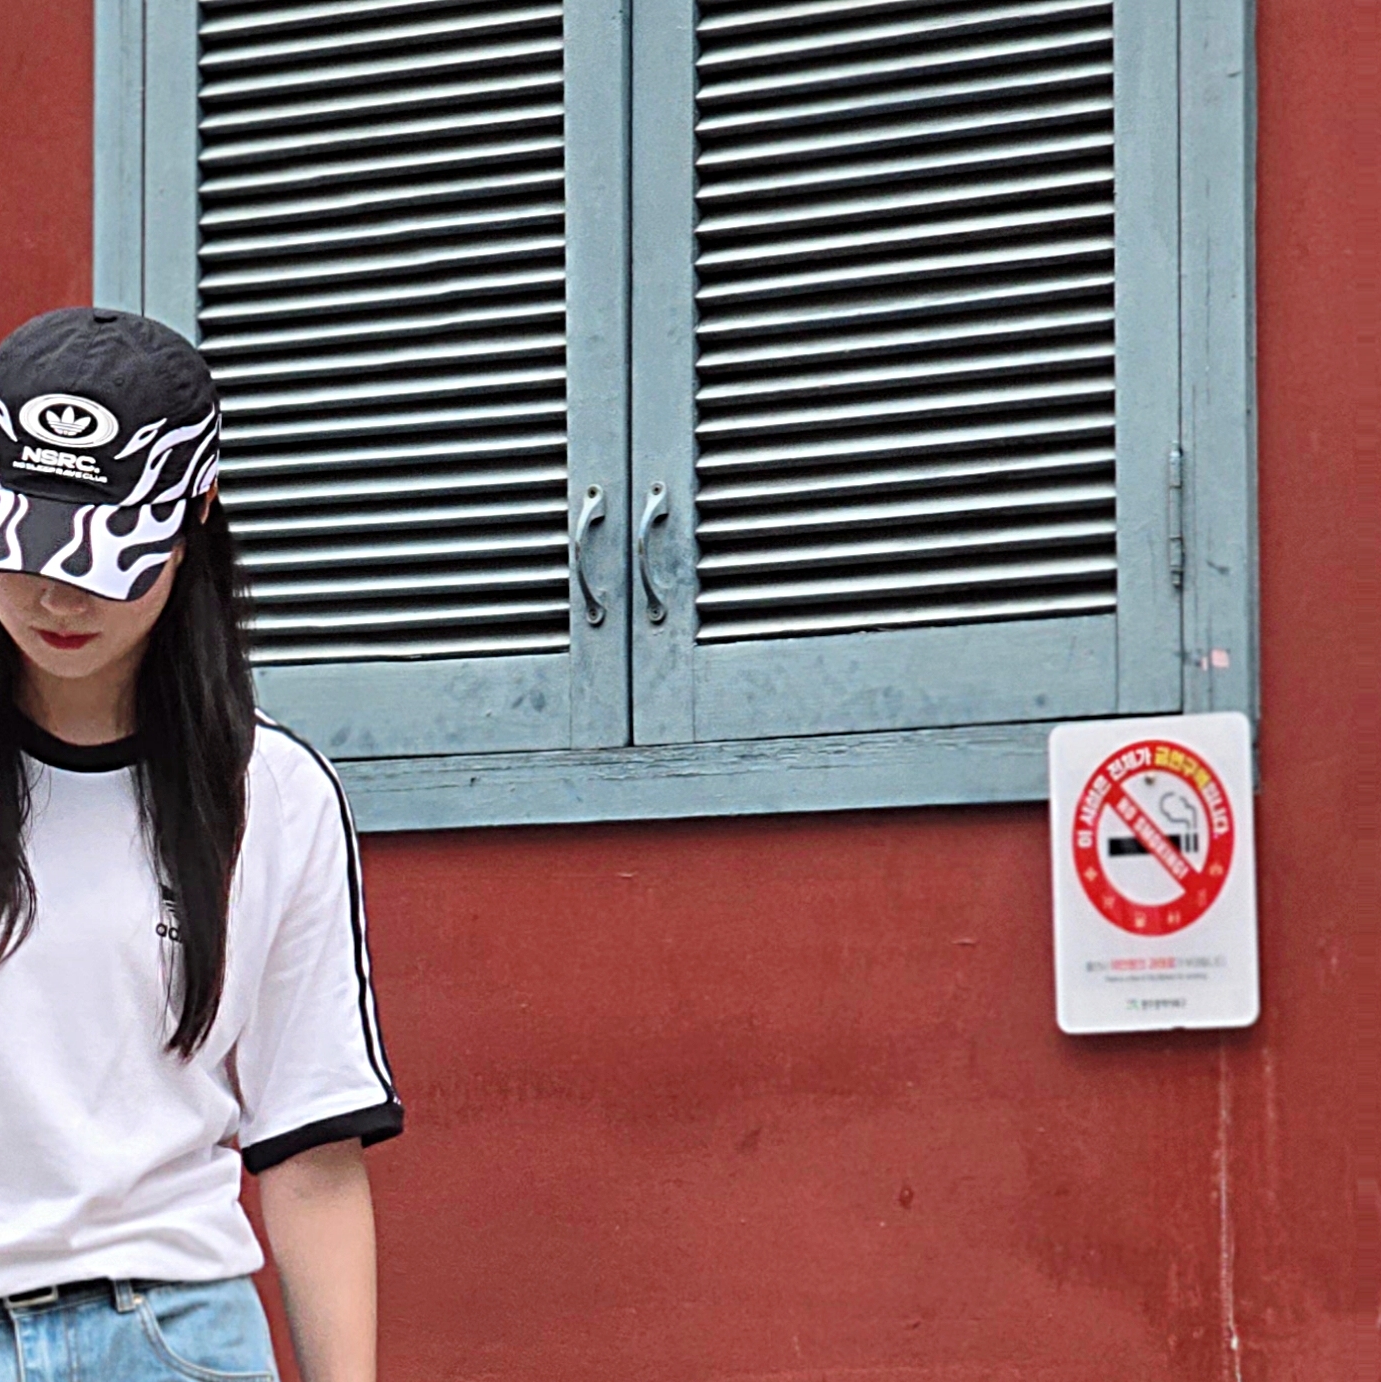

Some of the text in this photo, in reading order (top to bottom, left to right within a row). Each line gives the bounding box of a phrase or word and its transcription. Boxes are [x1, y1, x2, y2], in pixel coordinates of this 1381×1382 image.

[21, 445, 100, 474] NSRC.
[1116, 796, 1138, 821] NO
[1077, 829, 1093, 849] 이
